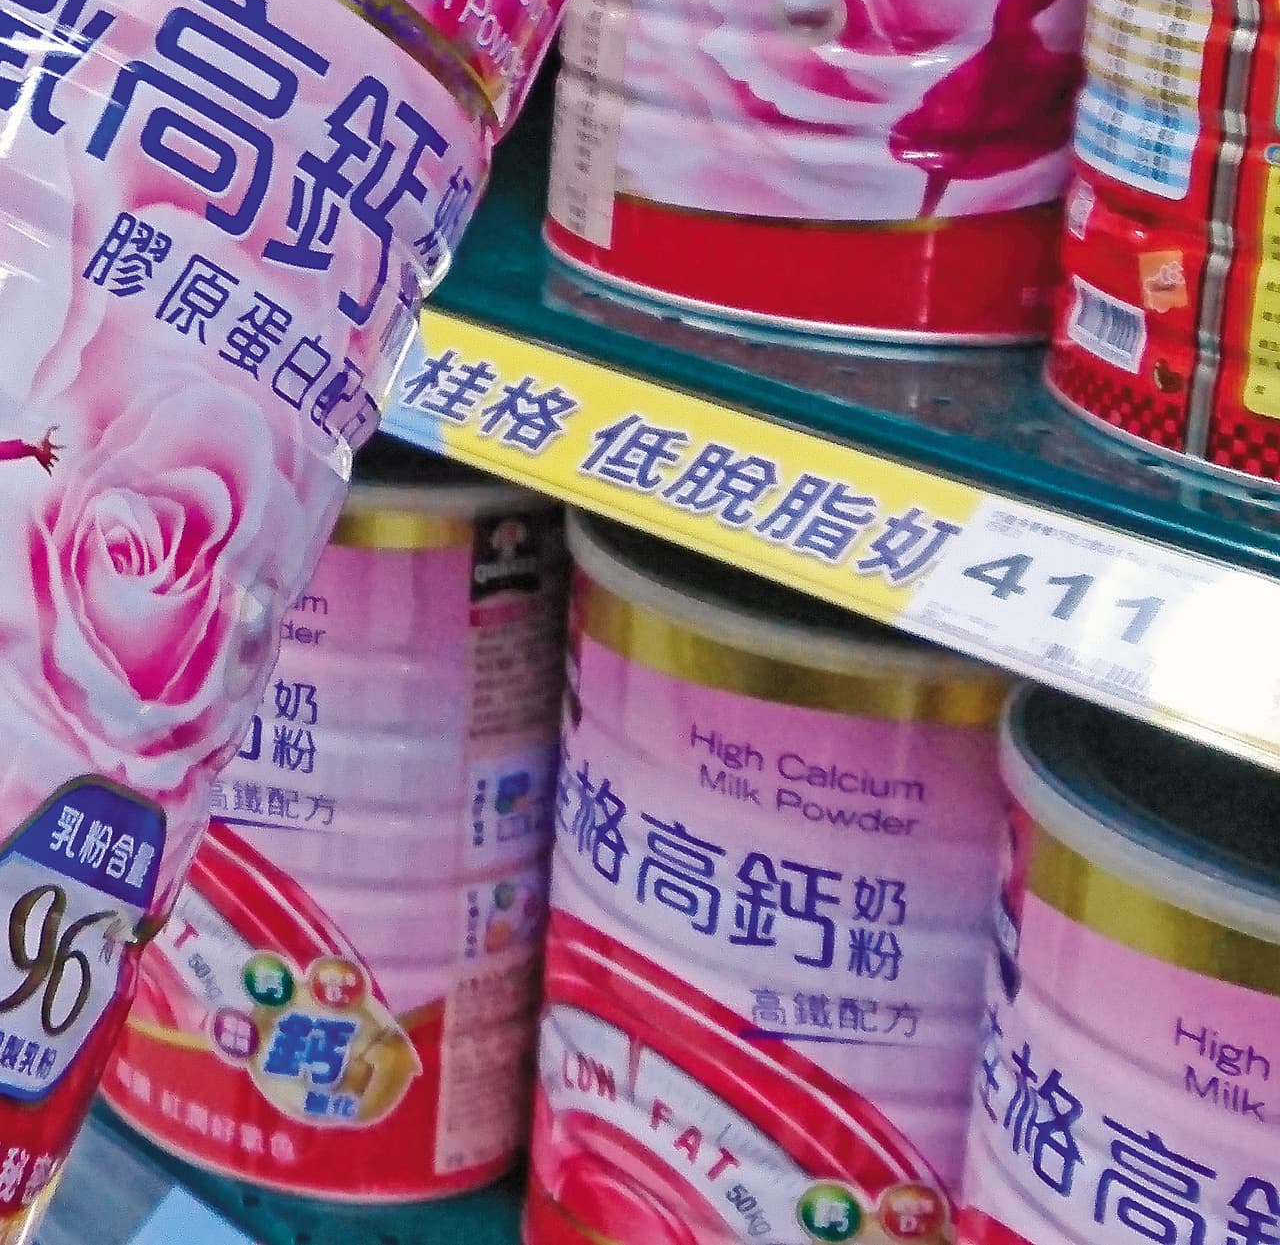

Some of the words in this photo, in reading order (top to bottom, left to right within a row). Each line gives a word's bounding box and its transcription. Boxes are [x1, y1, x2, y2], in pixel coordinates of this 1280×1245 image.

[401, 348, 580, 456] 桂格
[280, 621, 327, 645] der
[961, 552, 1165, 646] 411
[271, 677, 319, 774] 奶粉
[689, 723, 764, 772] High
[776, 752, 927, 804] Calcium
[698, 764, 762, 807] Milk
[774, 787, 922, 837] Powder
[49, 804, 157, 889] 乳粉含量
[846, 875, 908, 982] 奶粉
[1174, 1016, 1271, 1081] High
[560, 1050, 618, 1102] LOW
[649, 1098, 743, 1183] FAT
[1183, 1063, 1266, 1122] Milk
